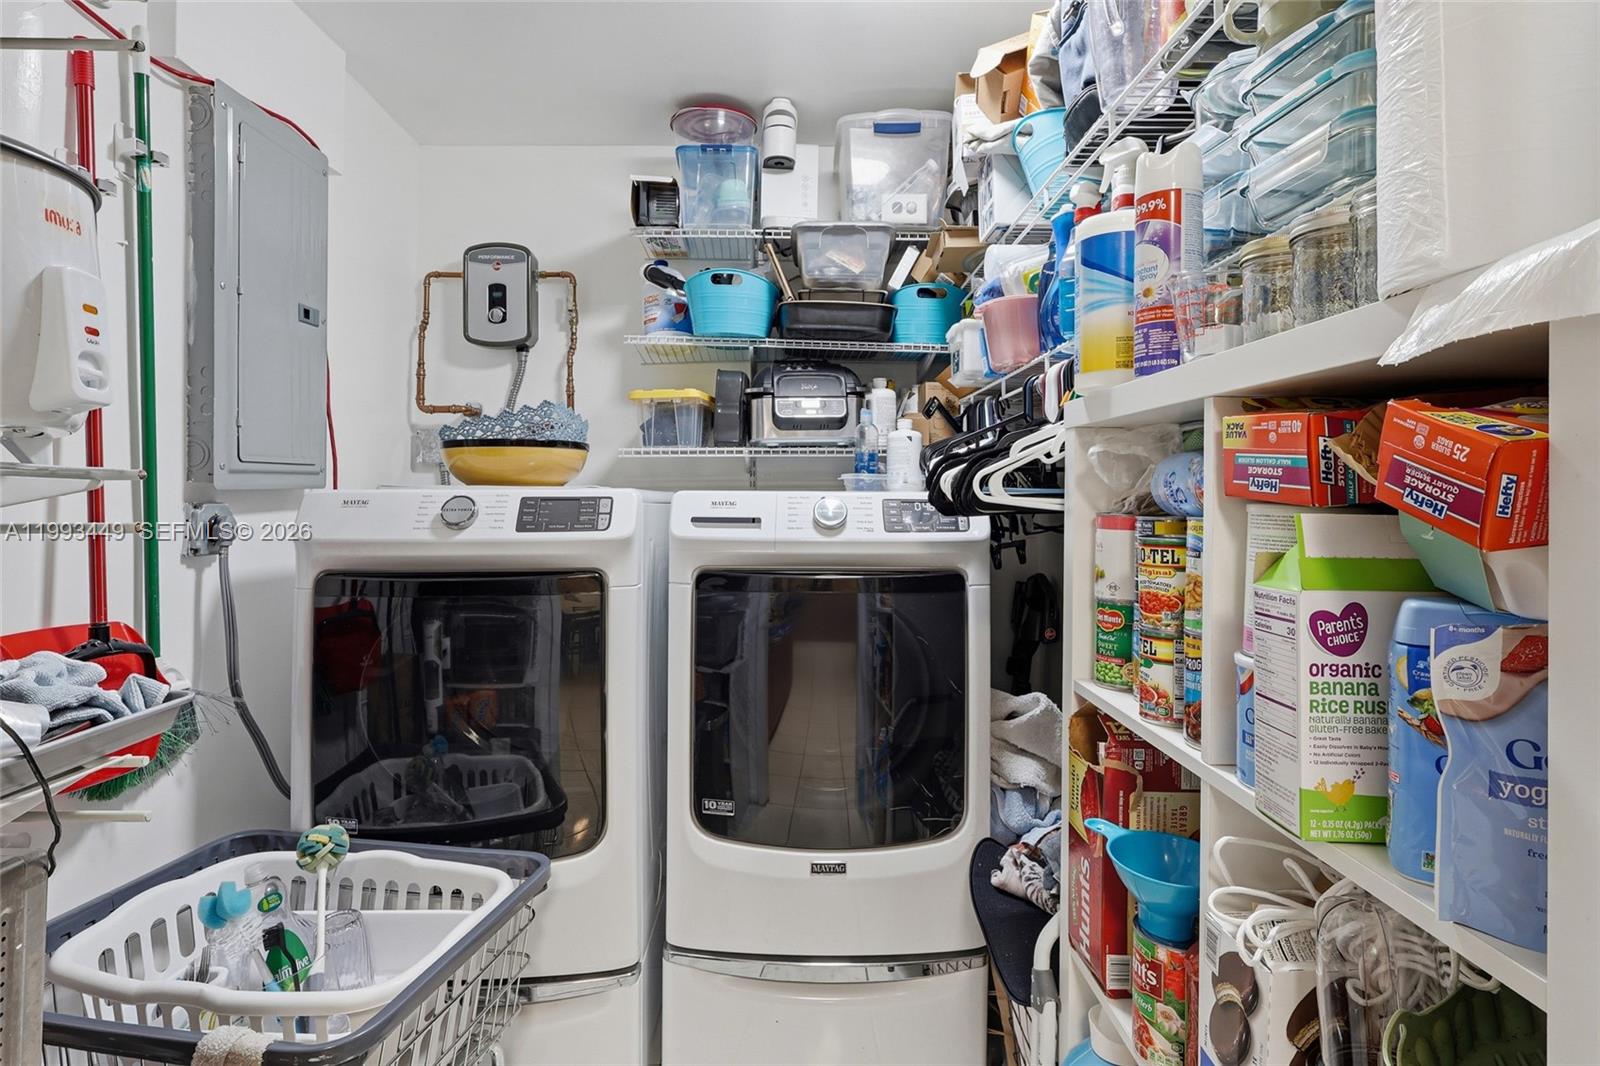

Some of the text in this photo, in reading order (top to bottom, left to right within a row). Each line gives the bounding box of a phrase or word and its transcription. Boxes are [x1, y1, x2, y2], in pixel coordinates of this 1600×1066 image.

[1226, 422, 1245, 430] PACK
[1291, 419, 1302, 433] 40
[1225, 430, 1248, 439] VALUE
[1437, 435, 1454, 448] BAGS
[1431, 441, 1452, 456] SLIDER
[1452, 443, 1471, 462] 25
[1247, 466, 1283, 475] STORAGE
[1250, 477, 1278, 492] Hefty
[1403, 474, 1456, 503] STORAGE
[1432, 479, 1460, 494] QUART
[1405, 488, 1446, 518] Hefty
[1498, 476, 1517, 516] Hefty
[1254, 590, 1296, 606] Nutrition Facts
[1254, 620, 1296, 636] Calories 30
[1317, 612, 1364, 637] Parent's
[1327, 632, 1360, 647] CHOICE
[1309, 661, 1382, 679] organic
[1309, 681, 1380, 697] Banana
[1309, 697, 1349, 715] Rice
[1309, 715, 1388, 726] Naturally Banana
[1309, 725, 1364, 735] Gluten-Free
[1312, 743, 1328, 751] Easily
[1359, 744, 1376, 752] Baby's
[704, 800, 717, 809] 10
[1170, 808, 1178, 829] TASTE
[1178, 805, 1188, 833] GREAT
[1344, 820, 1364, 830] (4.2g)
[1310, 830, 1372, 840] NET WT 1.76 OZ (50g)
[1503, 827, 1540, 843] NATURALLY
[812, 864, 845, 873] MAYTAG
